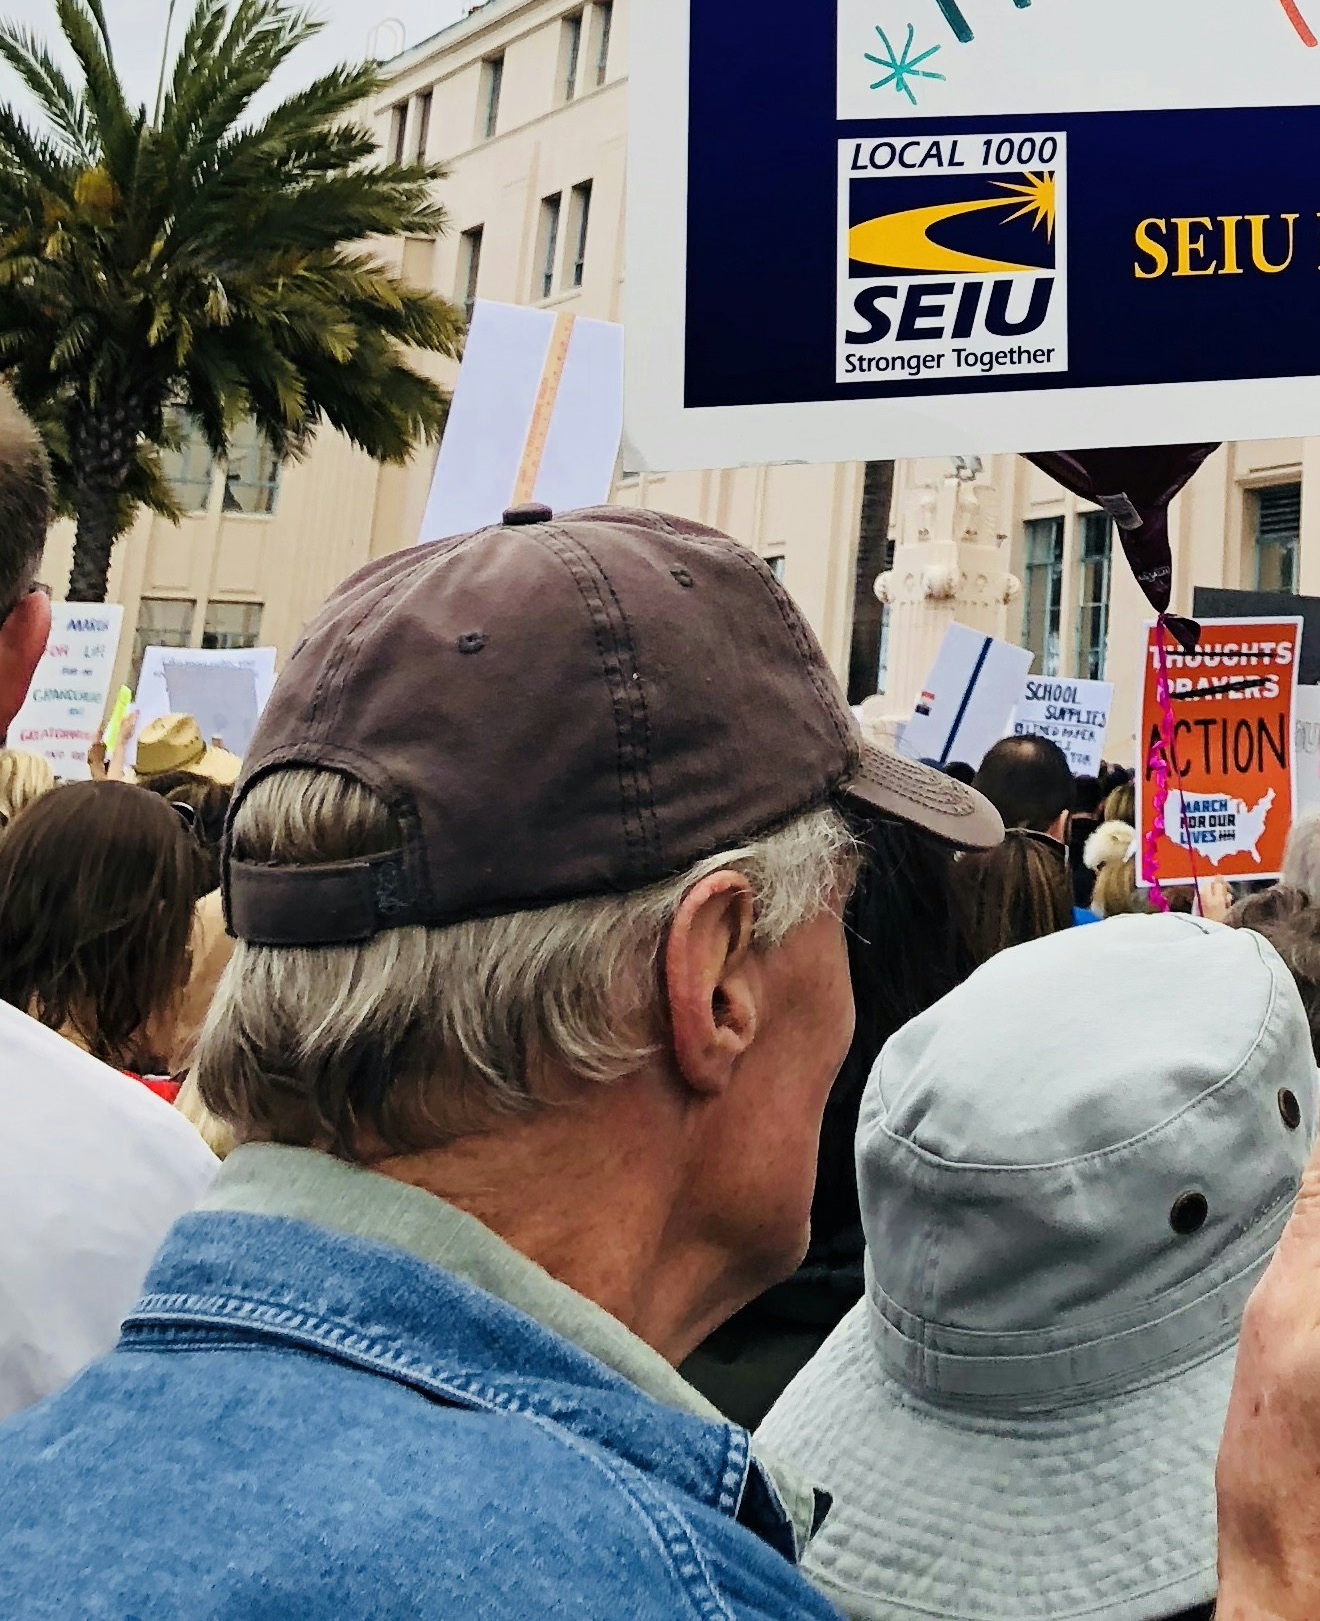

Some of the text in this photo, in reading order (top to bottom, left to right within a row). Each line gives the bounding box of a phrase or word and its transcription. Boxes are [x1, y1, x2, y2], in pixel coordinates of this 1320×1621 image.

[851, 136, 1057, 170] LOCAL 1000
[1134, 213, 1300, 278] SEIU
[845, 277, 1055, 344] SEIU
[845, 345, 1055, 376] Stronger Together
[1149, 641, 1293, 669] THOUGHTS
[1025, 681, 1081, 705] SCHOOL
[1157, 674, 1280, 702] PRAYERS
[1146, 713, 1286, 781] ACTION
[1181, 799, 1227, 813] MARCH
[1208, 813, 1235, 827] OUR
